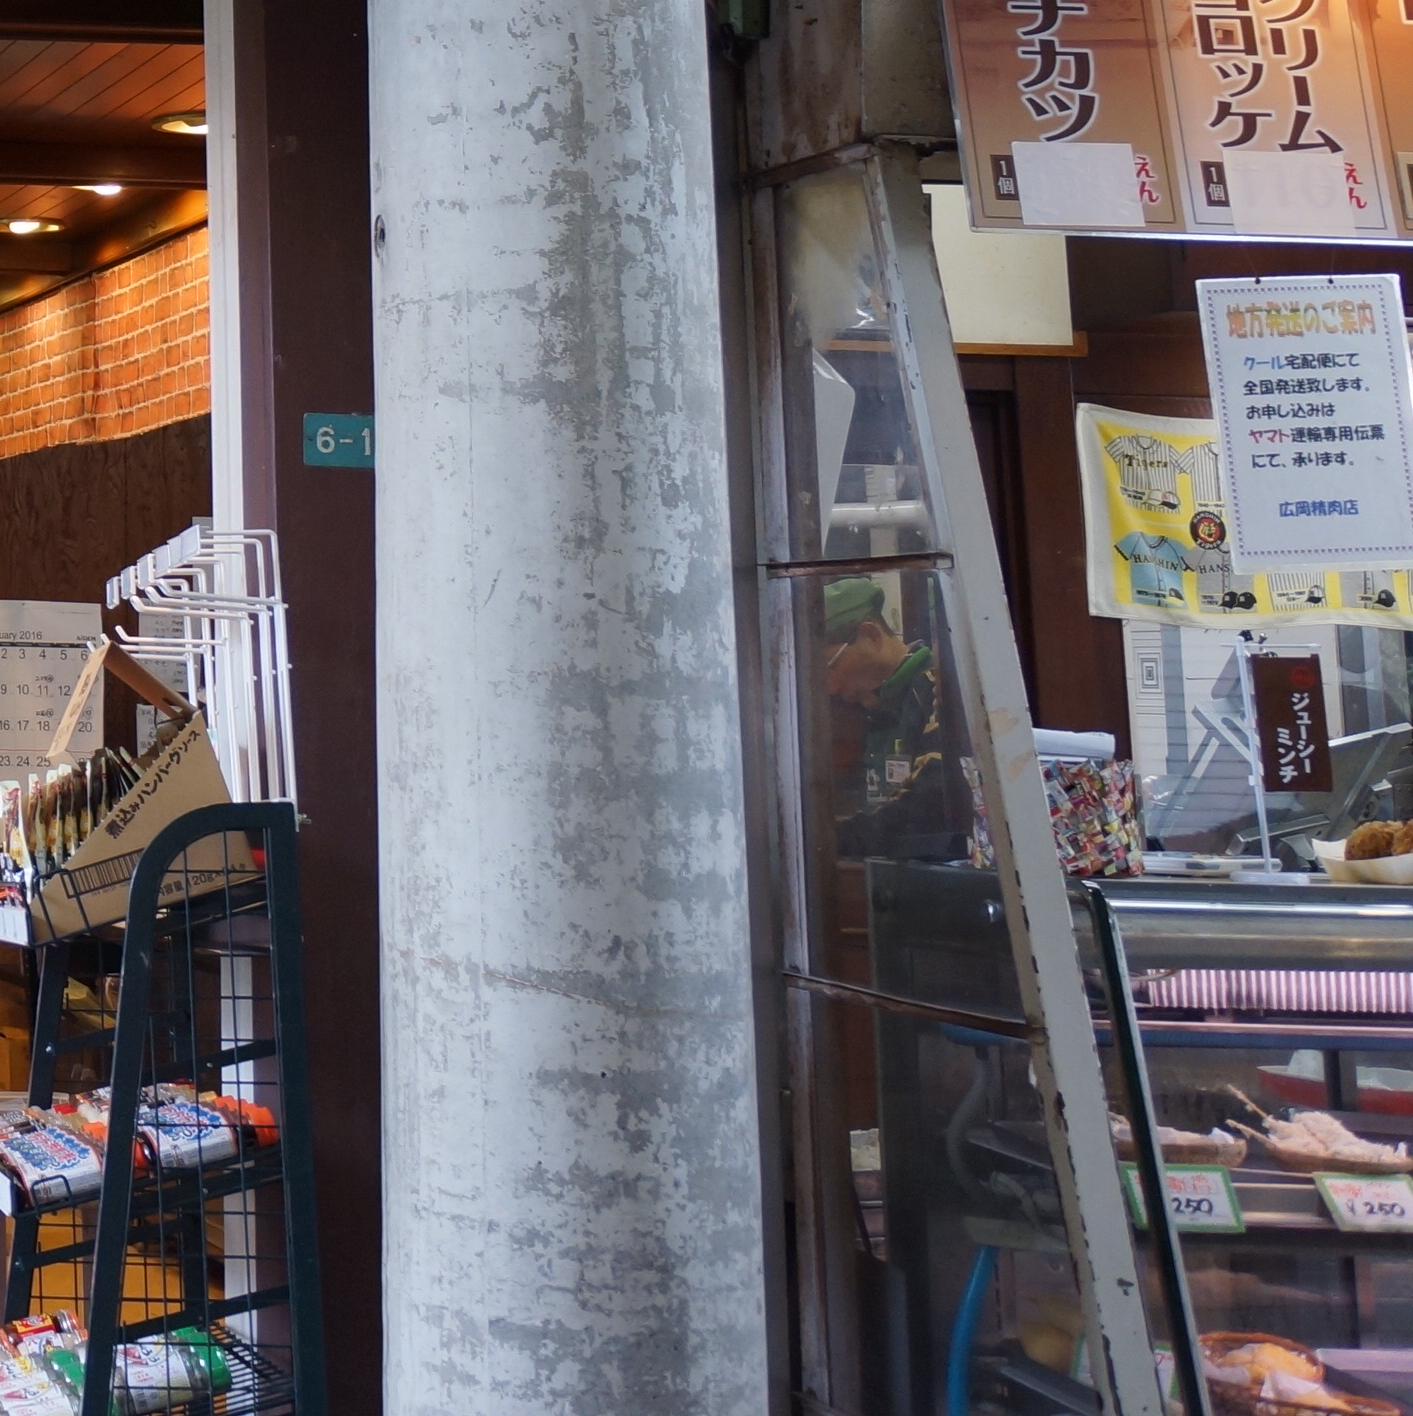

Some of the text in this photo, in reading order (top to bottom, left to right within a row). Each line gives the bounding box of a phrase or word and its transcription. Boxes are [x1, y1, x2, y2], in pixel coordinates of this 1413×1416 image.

[1226, 300, 1377, 339] 地方発送のご案内
[1243, 352, 1361, 371] クール宅配便にて
[1242, 378, 1371, 397] 全国発送致します。
[1246, 402, 1336, 421] お申し込みは
[1248, 424, 1386, 445] ヤマト運輸専用伝票
[1124, 453, 1169, 472] Tigers
[1251, 451, 1355, 470] にて、承ります。
[1278, 499, 1360, 518] 広岡精肉店
[1133, 553, 1179, 572] HAHIN
[19, 630, 43, 640] 2016
[0, 649, 8, 660] 2
[18, 649, 26, 660] 3
[38, 649, 47, 660] 4
[59, 649, 68, 661] 5
[0, 684, 8, 695] 9
[17, 684, 30, 696] 10
[37, 684, 49, 696] 11
[58, 685, 71, 697] 12
[17, 720, 29, 731] 17
[37, 720, 51, 732] 18
[77, 721, 93, 733] 20
[1291, 691, 1316, 775] ジューシー
[16, 755, 30, 767] 24
[36, 756, 51, 768] 25
[1276, 726, 1299, 784] ミンチ
[104, 729, 201, 840] 煮込みハンバーグソース
[1171, 1196, 1214, 1214] 250
